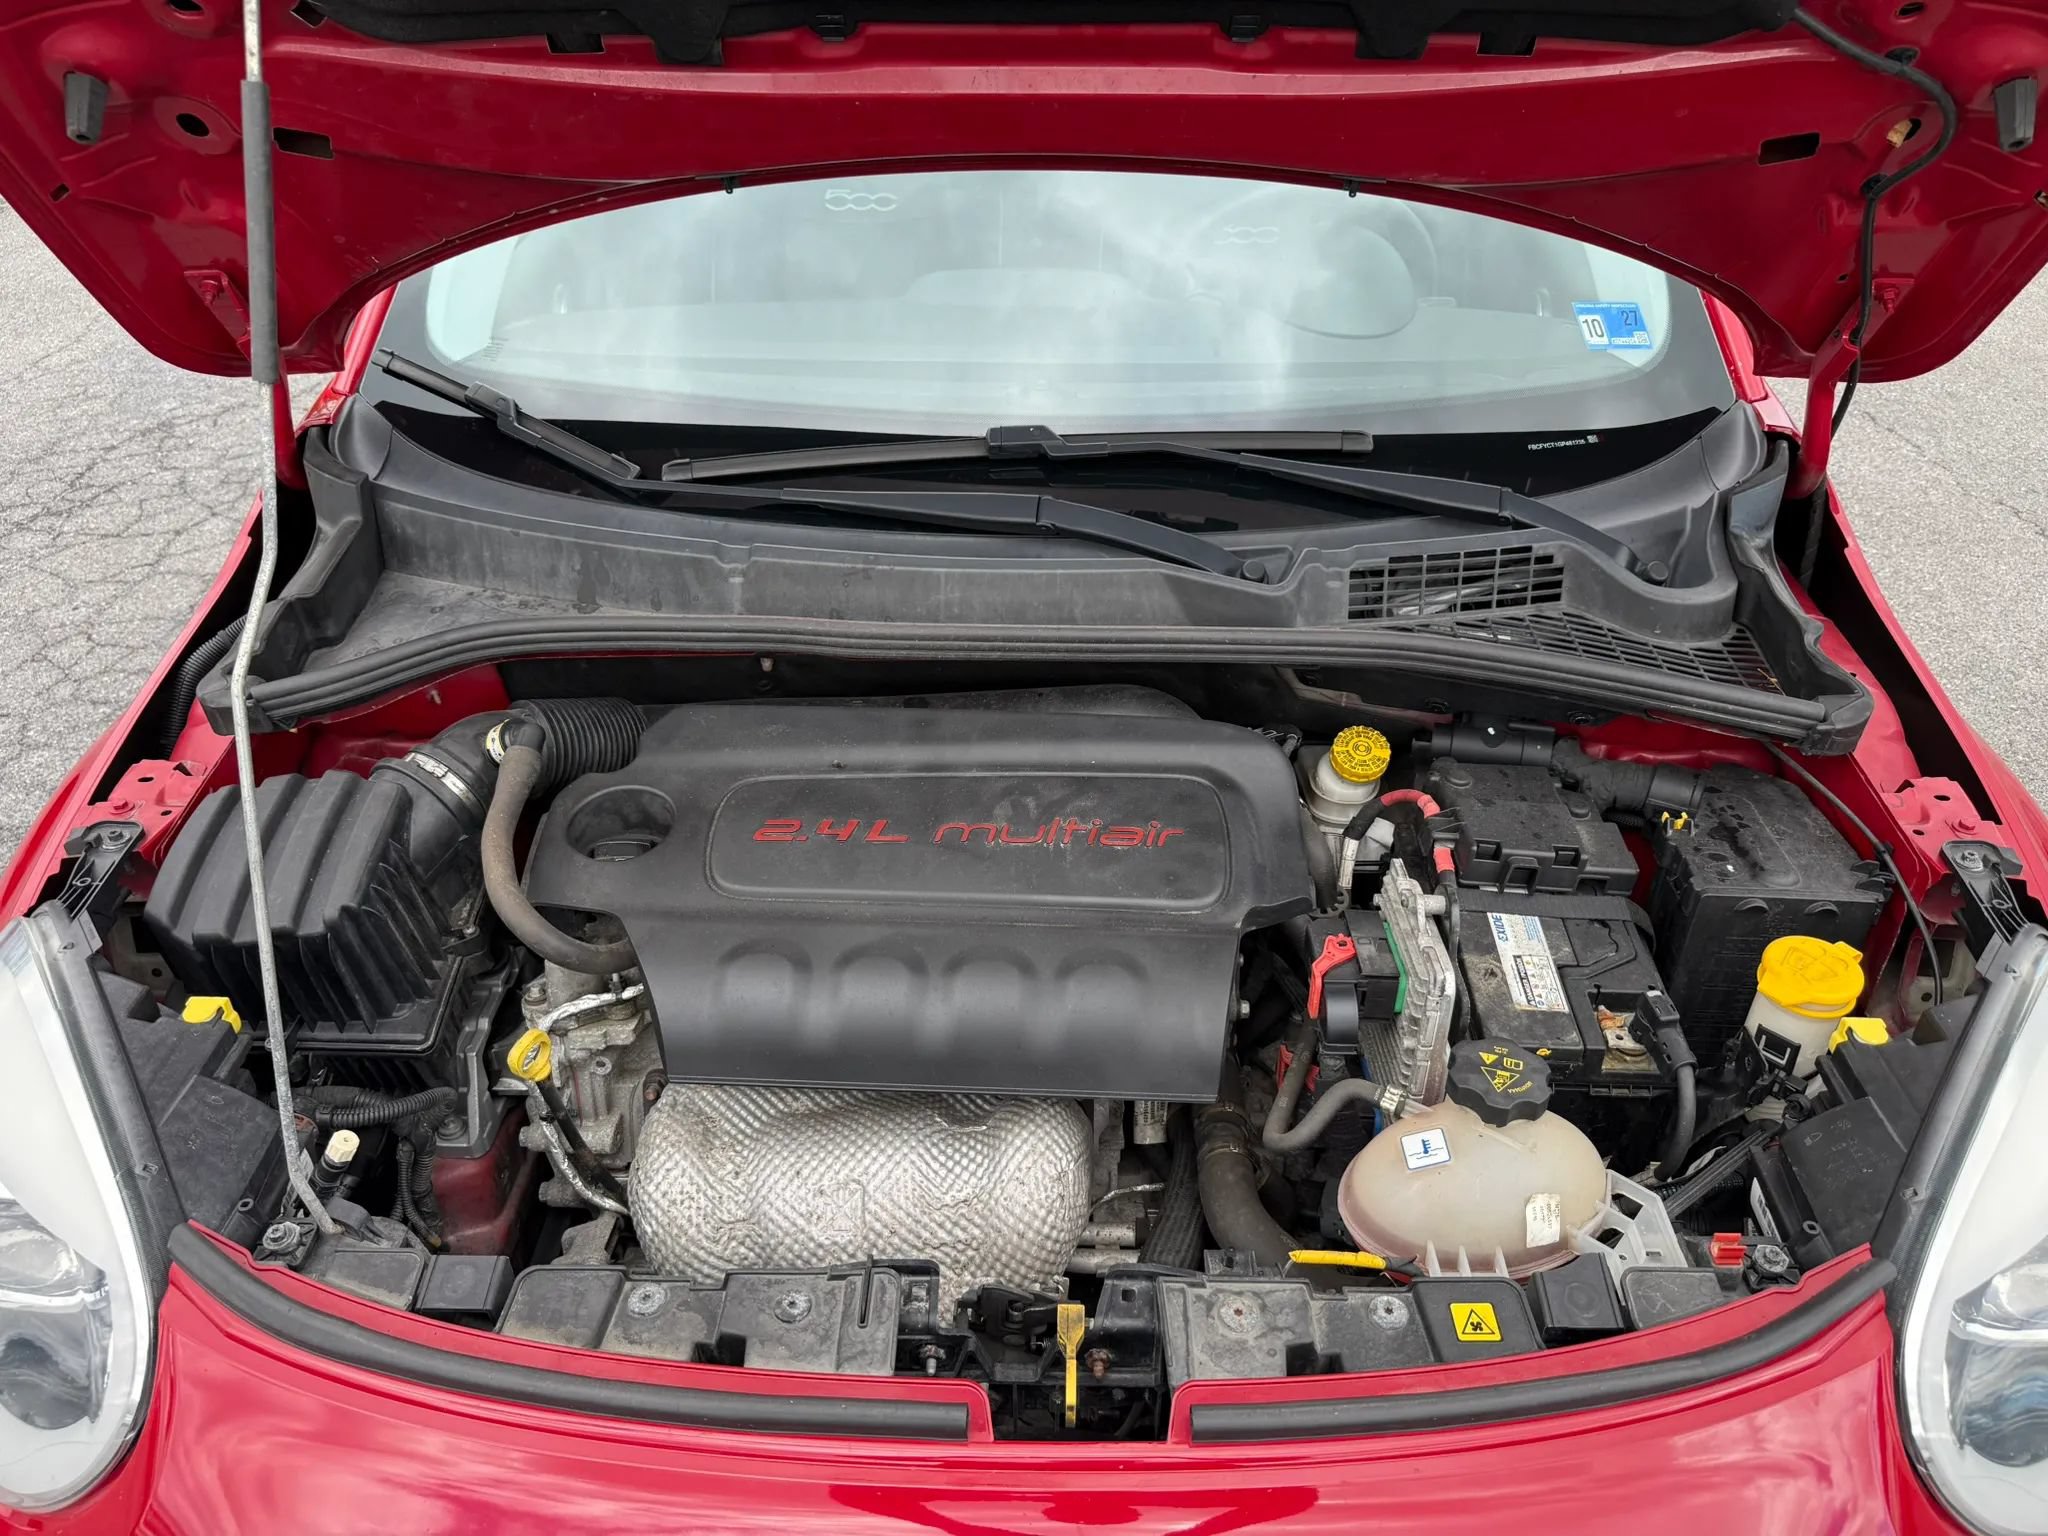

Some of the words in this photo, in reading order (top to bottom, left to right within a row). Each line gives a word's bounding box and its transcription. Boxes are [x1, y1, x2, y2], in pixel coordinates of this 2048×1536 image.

[824, 189, 897, 211] 500
[1582, 318, 1604, 338] 10
[1621, 310, 1638, 326] 27
[934, 817, 1184, 848] multiair
[1492, 914, 1508, 943] EXIDE
